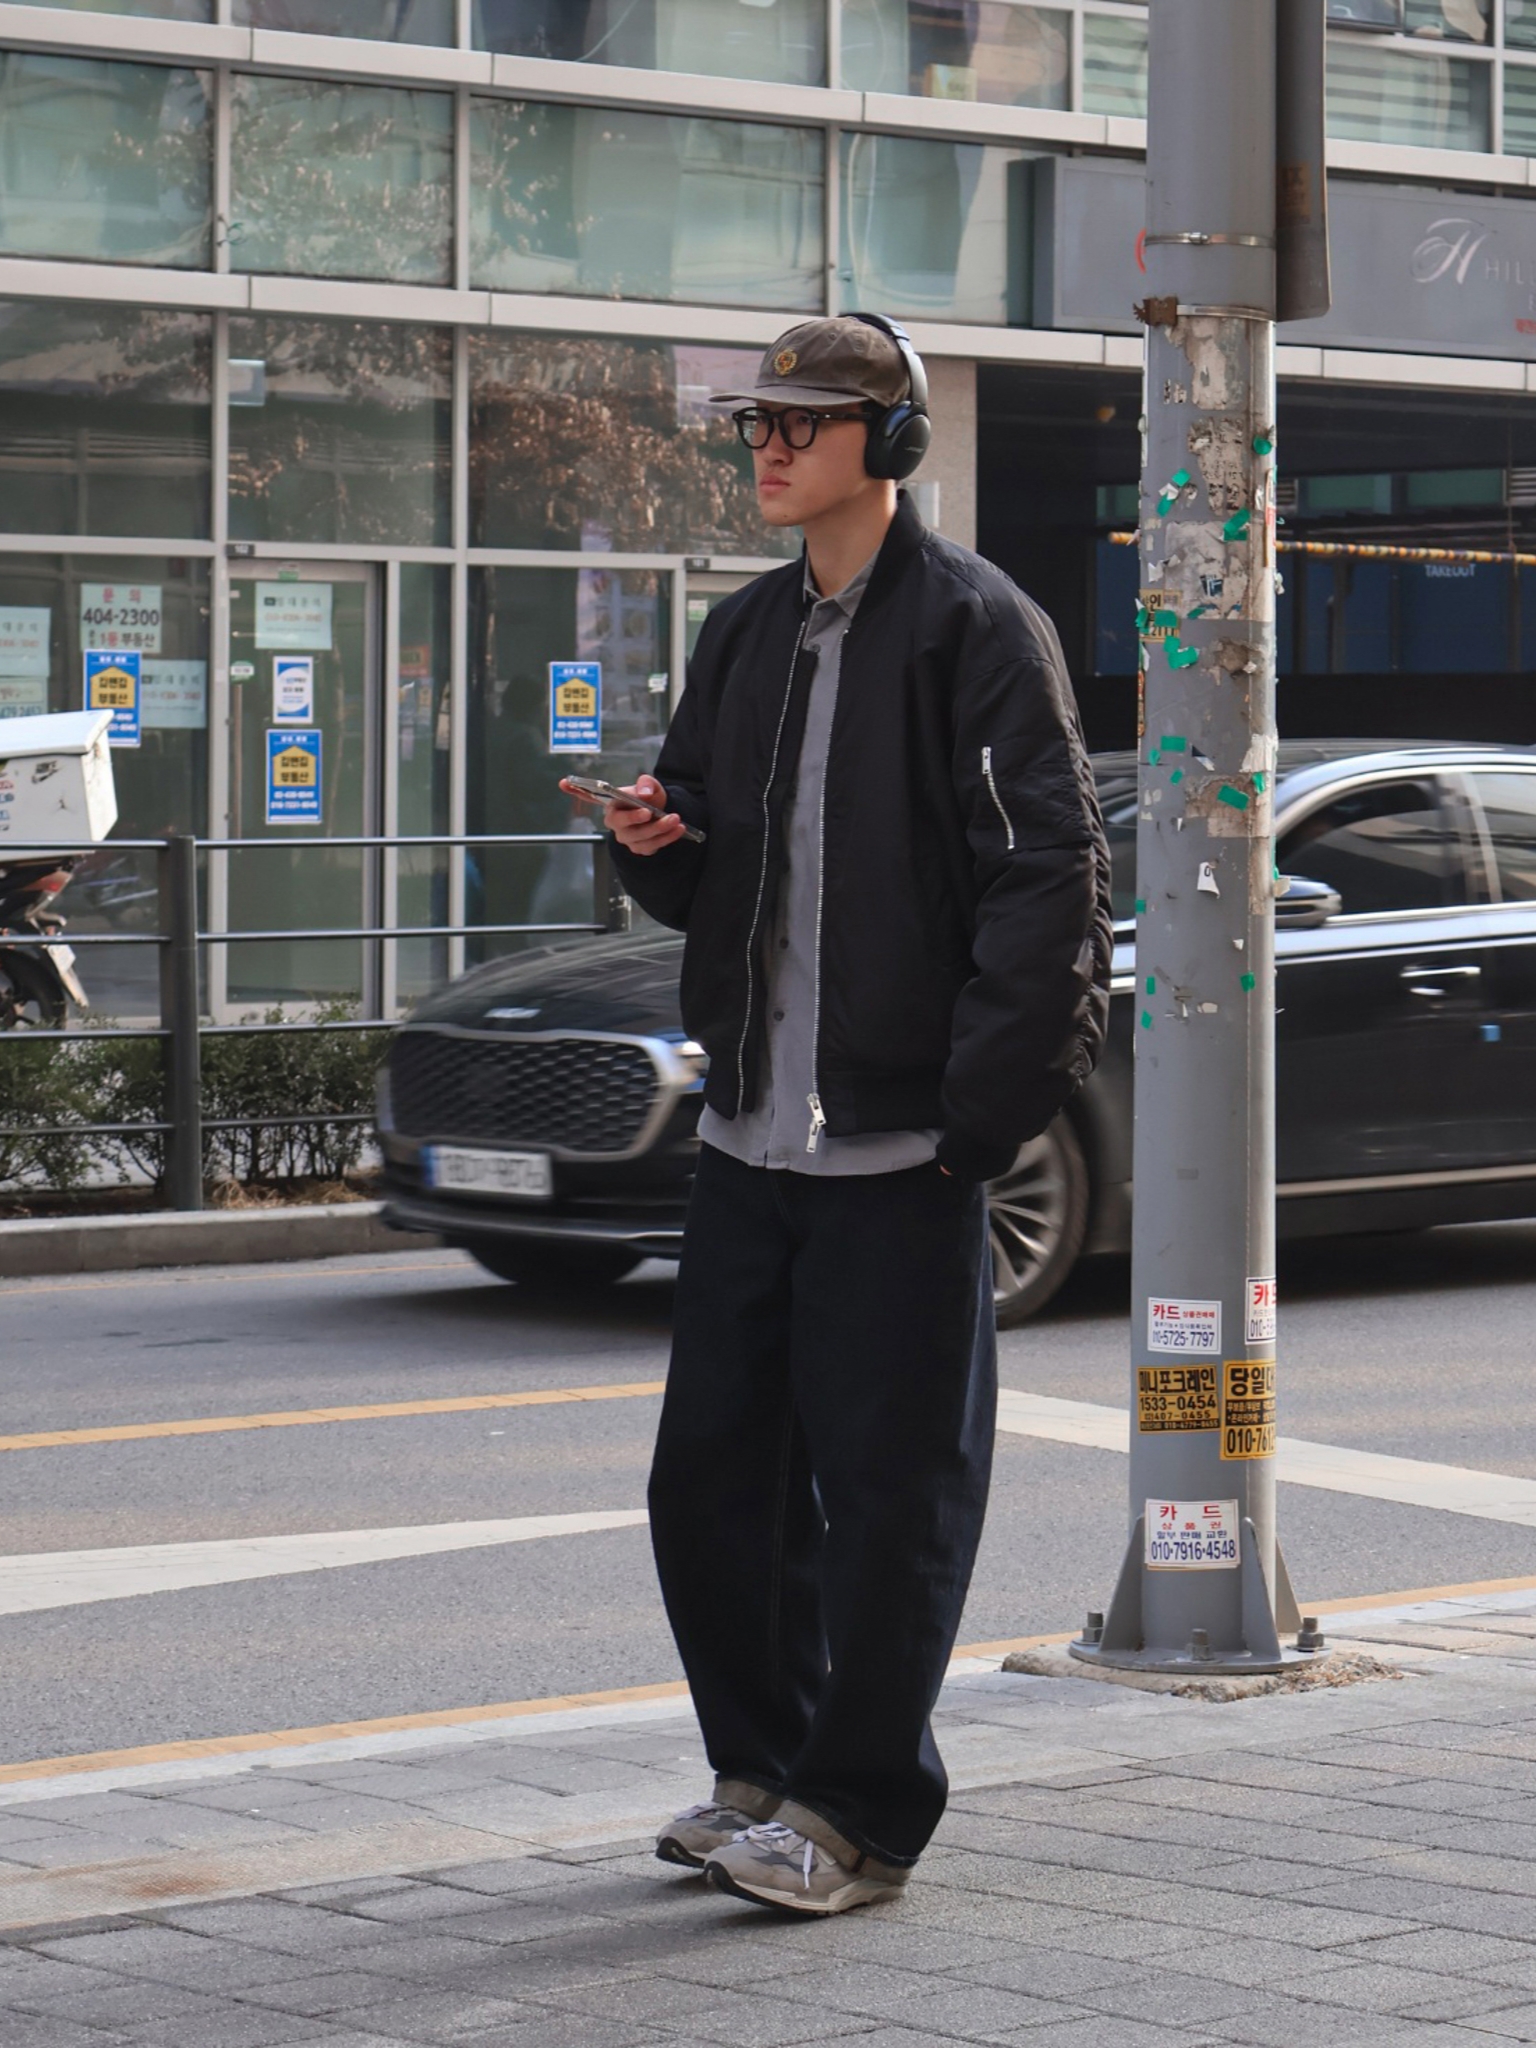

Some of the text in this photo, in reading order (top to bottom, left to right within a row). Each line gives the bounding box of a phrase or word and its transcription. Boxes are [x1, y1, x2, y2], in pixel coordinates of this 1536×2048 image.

[83, 607, 160, 626] 404-2300
[1153, 1304, 1181, 1320] 카드
[1139, 1368, 1215, 1393] 미니포크레인
[1140, 1394, 1216, 1411] 1533-0454
